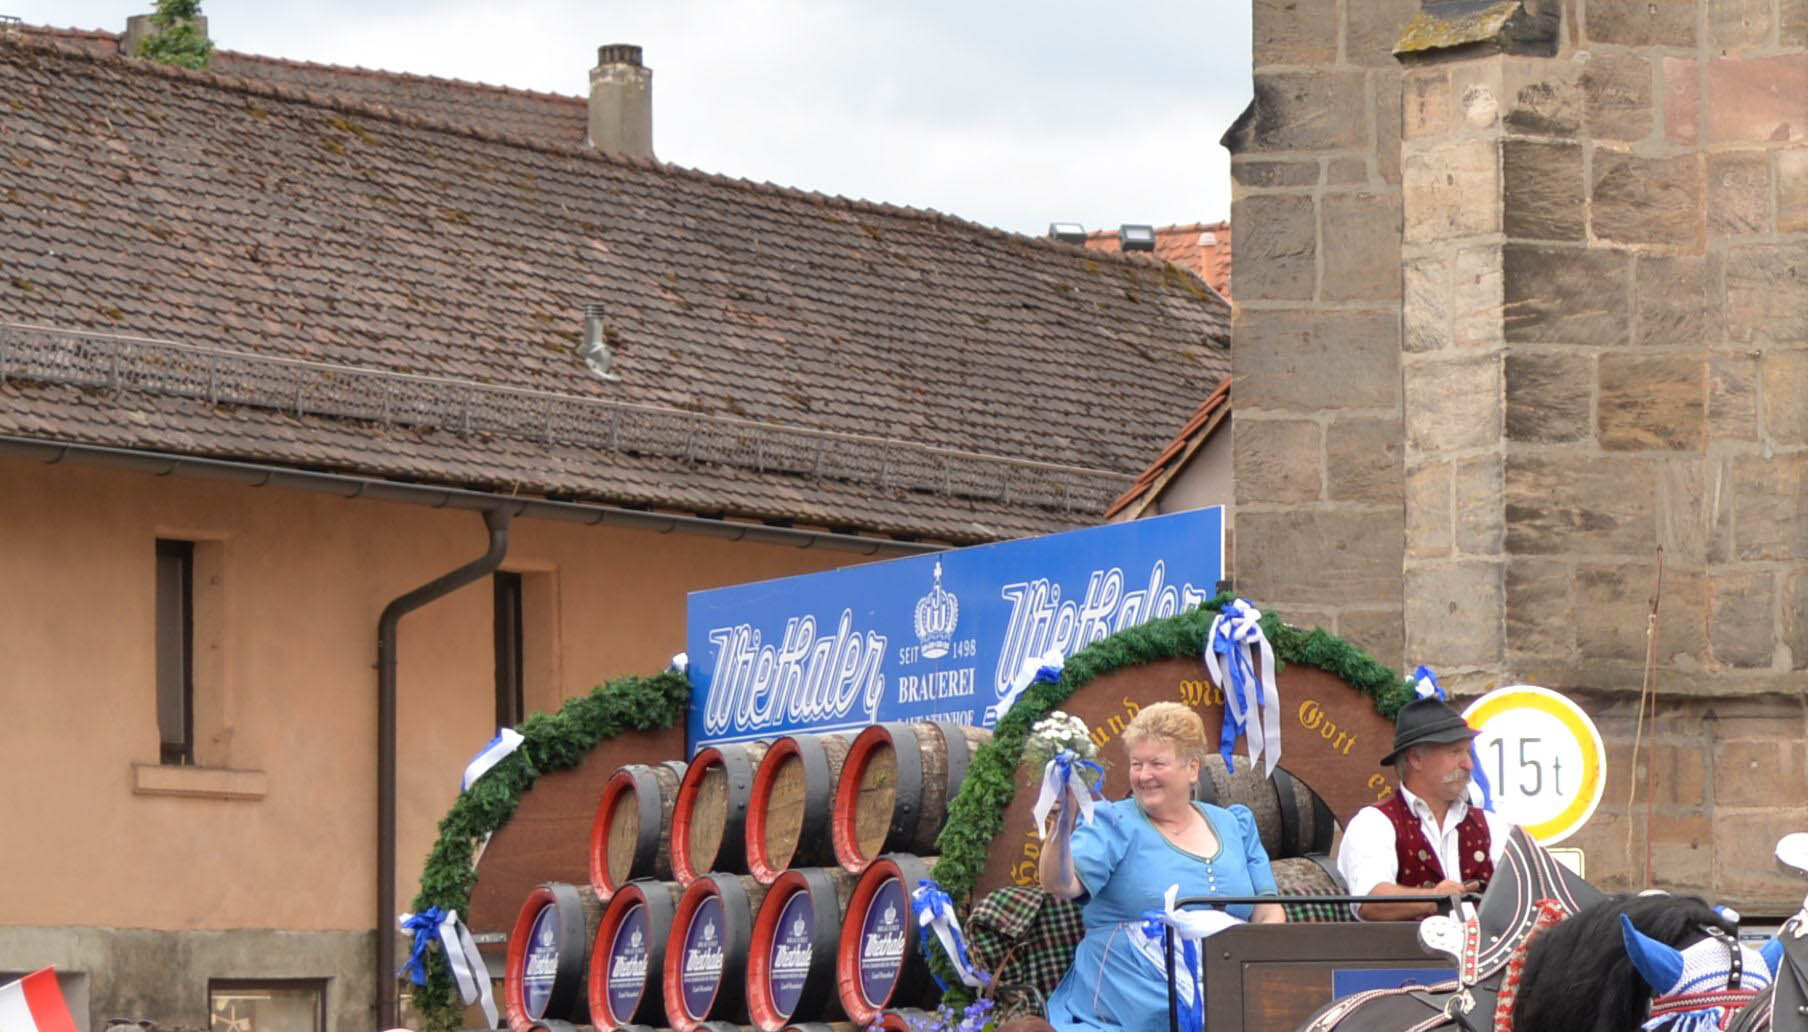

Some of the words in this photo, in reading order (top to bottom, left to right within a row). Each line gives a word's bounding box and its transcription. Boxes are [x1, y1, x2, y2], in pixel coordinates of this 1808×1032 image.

[703, 608, 888, 737] Wiethaler
[899, 646, 919, 665] SEIT
[953, 639, 976, 659] 1498
[898, 667, 976, 704] BRAUEREI
[1298, 699, 1358, 756] Gott
